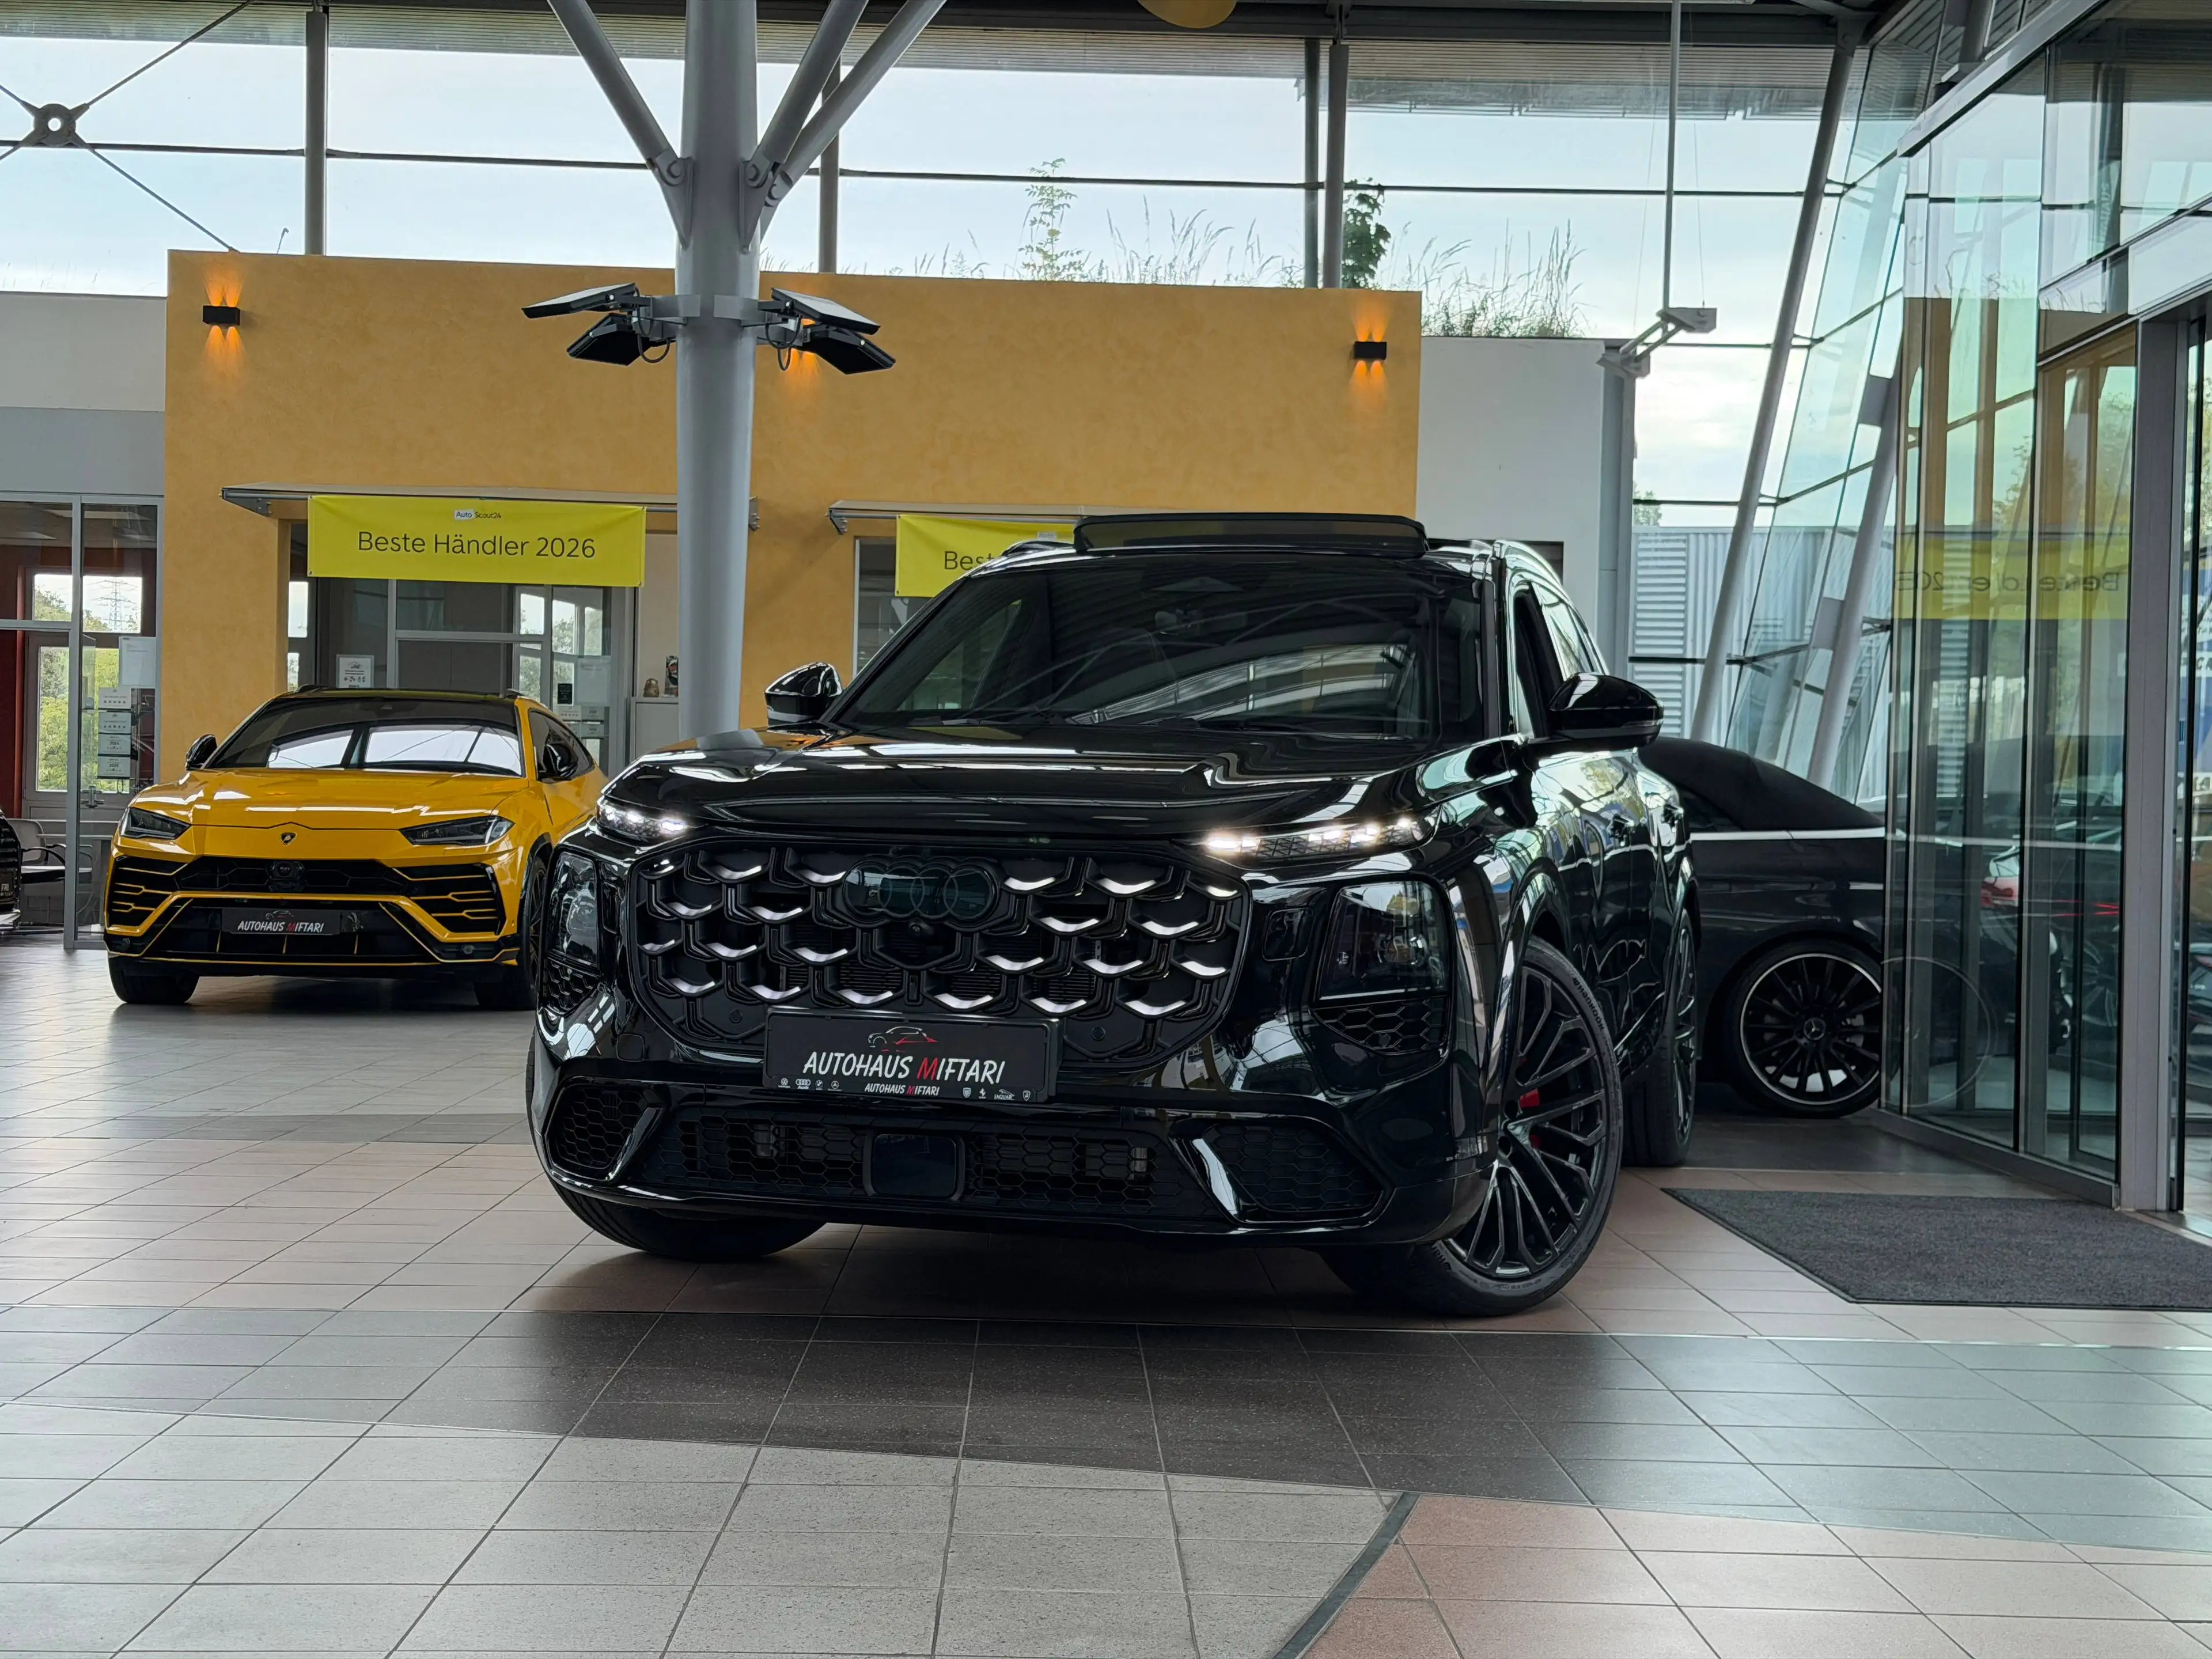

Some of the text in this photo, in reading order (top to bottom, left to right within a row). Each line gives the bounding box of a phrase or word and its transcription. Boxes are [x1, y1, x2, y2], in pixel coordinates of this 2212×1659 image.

[358, 532, 595, 558] Beste Händler 2026
[237, 921, 324, 933] AUTOHAUS MIFTARI
[803, 1052, 1006, 1085] AUTOHAUS MIFTARI
[865, 1082, 940, 1096] AUTOHAUS MIFTARI
